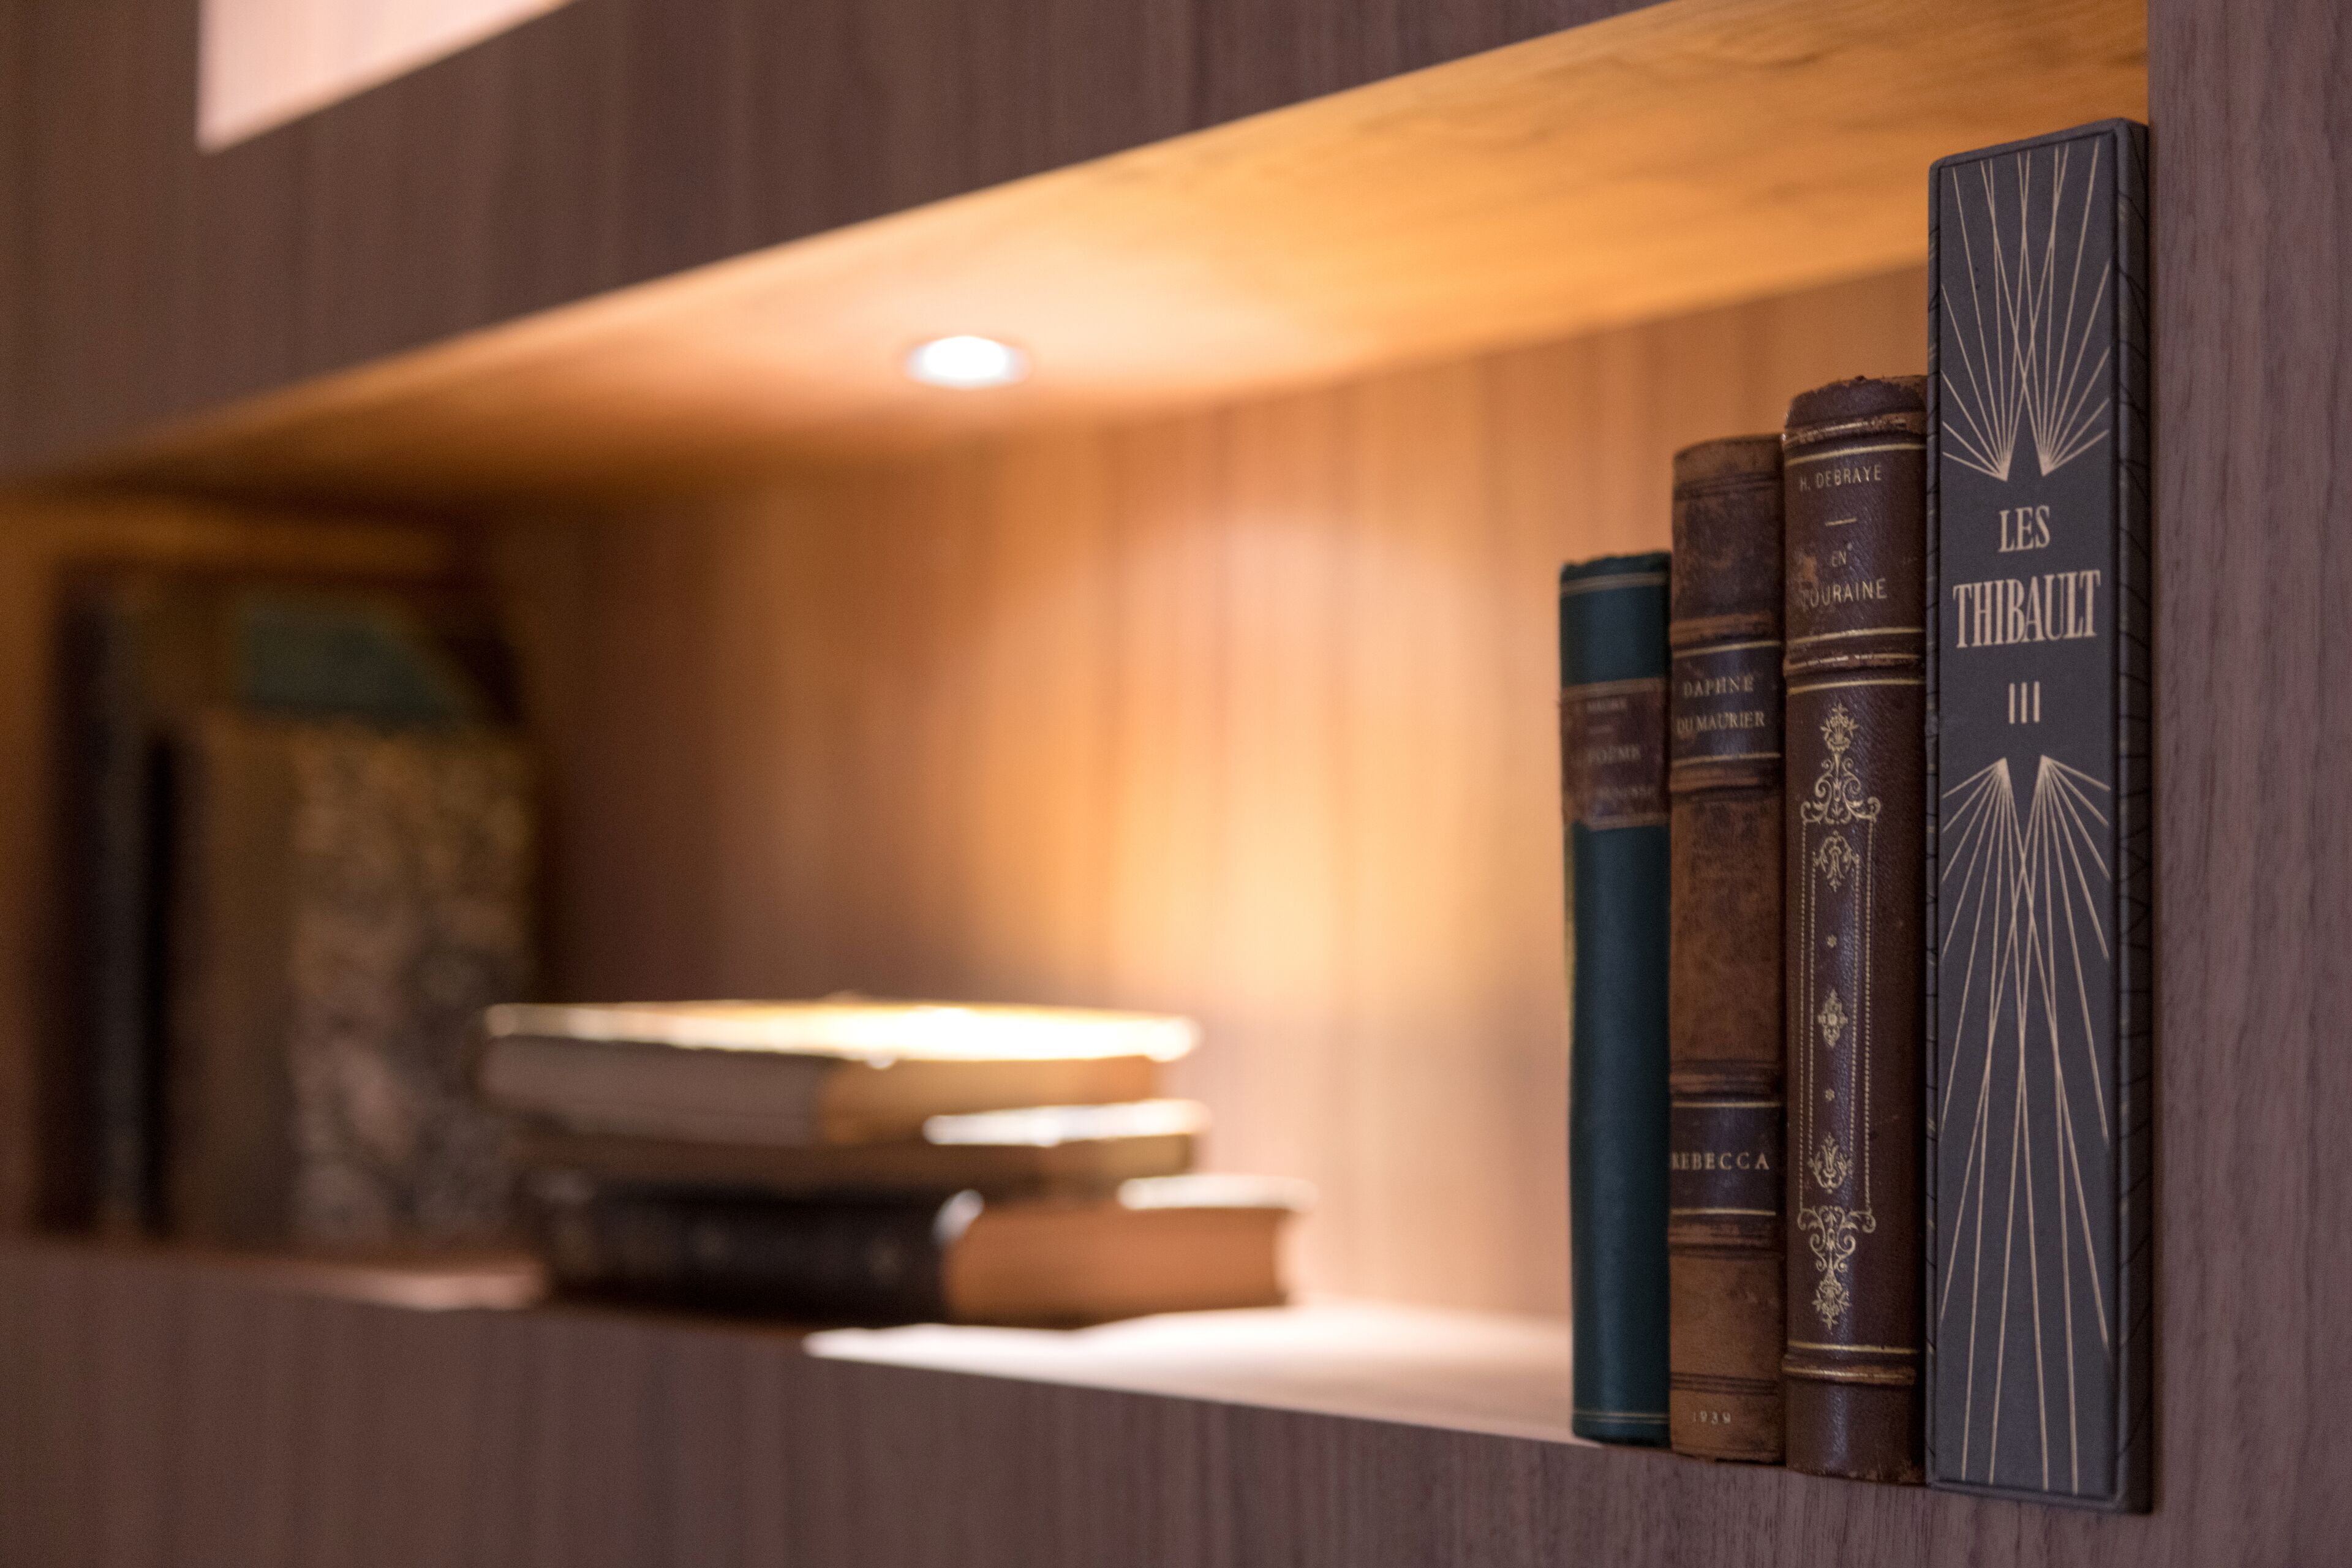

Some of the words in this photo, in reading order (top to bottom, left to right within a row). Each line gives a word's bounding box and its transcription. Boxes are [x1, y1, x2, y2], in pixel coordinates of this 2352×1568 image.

[1815, 464, 1882, 489] DEBRAYE
[1998, 504, 2051, 552] LES
[1831, 550, 1847, 568] EN
[1953, 569, 2101, 648] THIBAULT
[1684, 673, 1754, 698] DAPHNE
[2008, 680, 2041, 725] III
[1670, 1151, 1770, 1170] REBECCA
